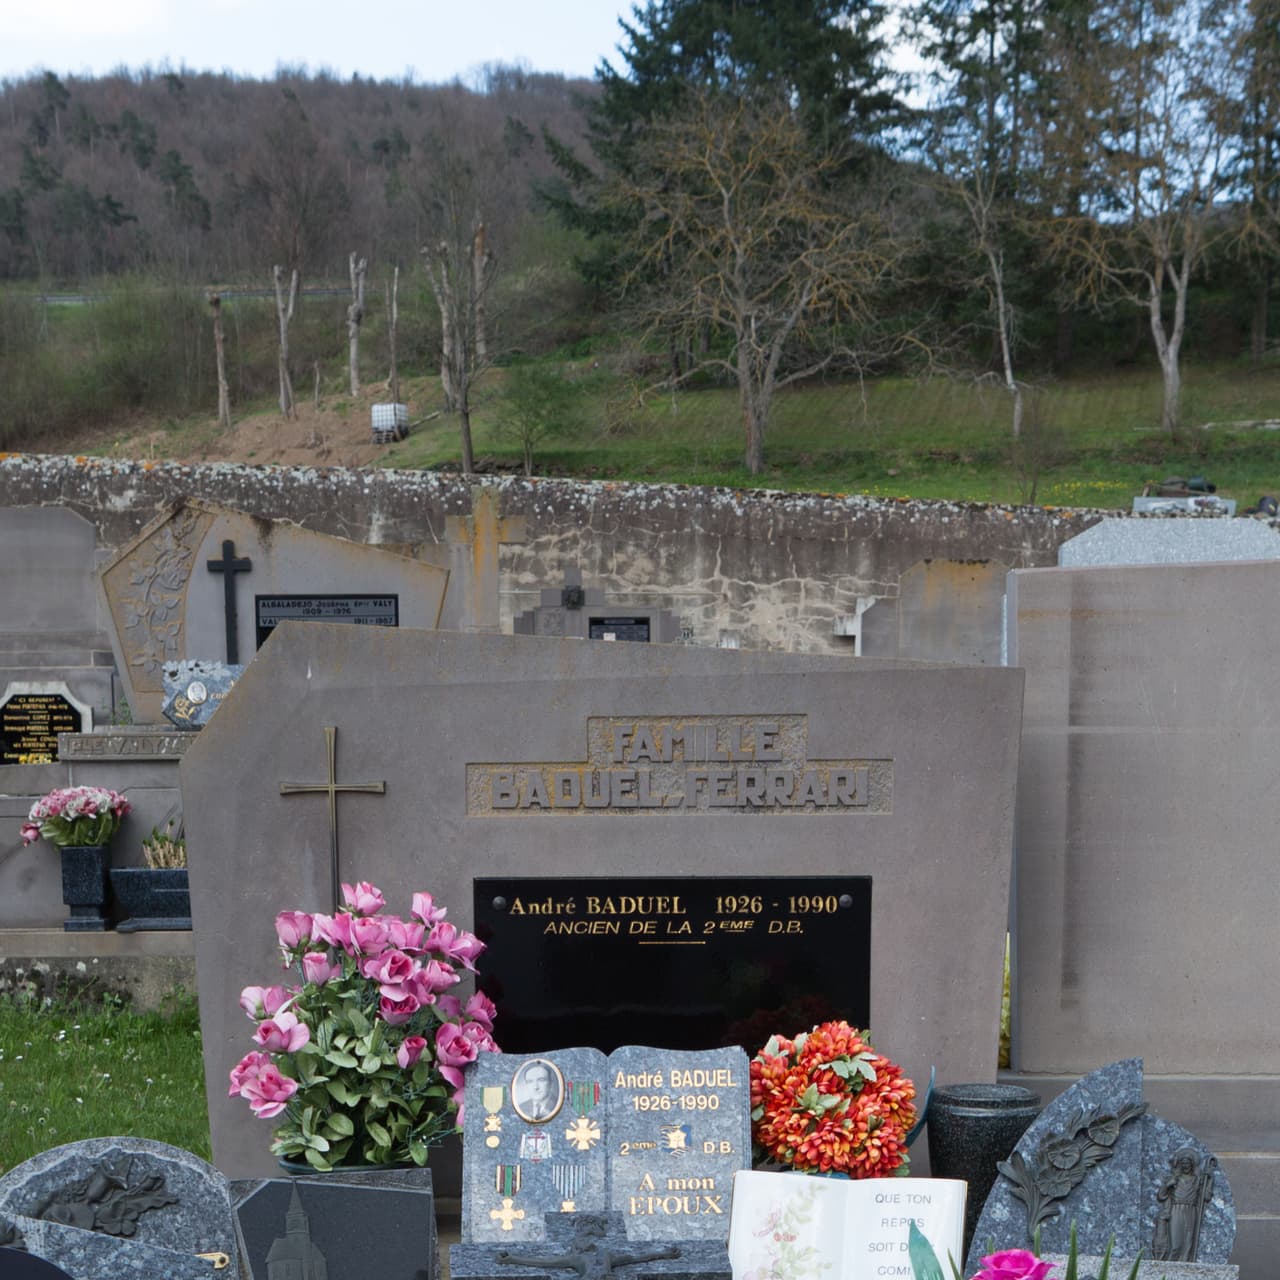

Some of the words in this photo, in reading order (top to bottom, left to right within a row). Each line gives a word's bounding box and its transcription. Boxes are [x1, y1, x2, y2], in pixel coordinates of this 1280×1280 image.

[613, 722, 783, 762] FAMILLE
[491, 768, 870, 809] BADUEL-FERRARI
[509, 896, 577, 915] André
[586, 896, 687, 915] BADUEL
[715, 895, 763, 914] 1926
[788, 895, 838, 914] 1990
[544, 921, 620, 935] ANCIEN
[629, 921, 658, 935] DE
[666, 921, 693, 935] LA
[768, 921, 805, 934] D.B.
[614, 1070, 663, 1088] André
[671, 1069, 737, 1088] BADUEL
[632, 1095, 720, 1111] 1926-1990
[703, 1141, 736, 1154] D.B.
[639, 1173, 655, 1191] A
[668, 1177, 715, 1191] mon
[630, 1196, 723, 1215] EPOUX
[875, 1193, 901, 1204] QUE
[906, 1193, 932, 1204] TON
[868, 1242, 895, 1253] SOIT
